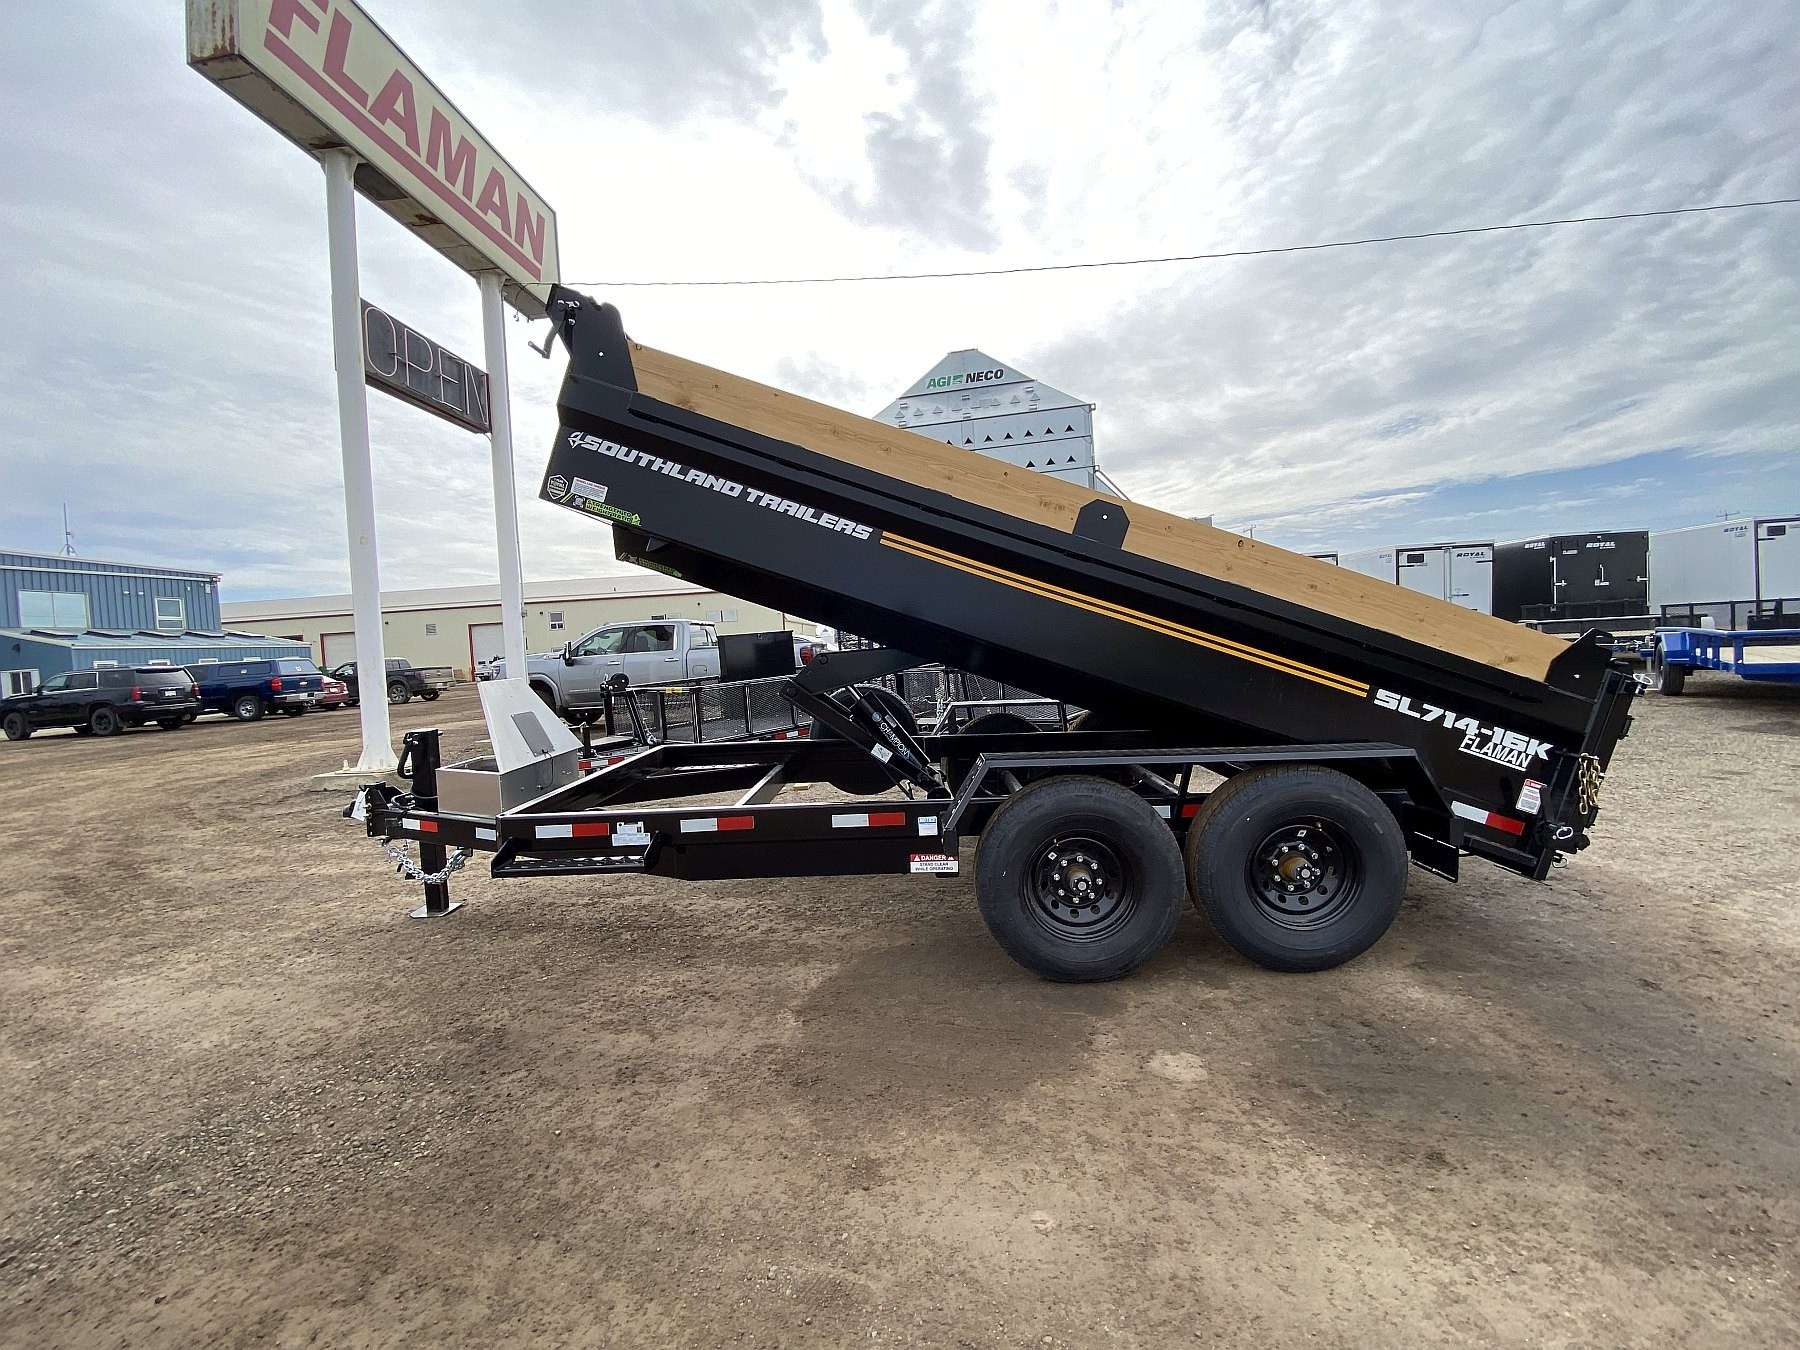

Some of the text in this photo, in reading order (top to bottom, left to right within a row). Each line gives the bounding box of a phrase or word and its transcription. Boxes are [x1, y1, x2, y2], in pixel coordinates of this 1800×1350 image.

[268, 0, 545, 267] FLAMAN
[365, 306, 488, 425] OPEN
[926, 369, 1004, 389] AGI NECO
[581, 434, 874, 541] SOUTHLAND TRAILERS
[880, 722, 910, 758] CHAMPION
[1373, 688, 1553, 760] SL714-16K
[1460, 734, 1533, 769] FLAMAN
